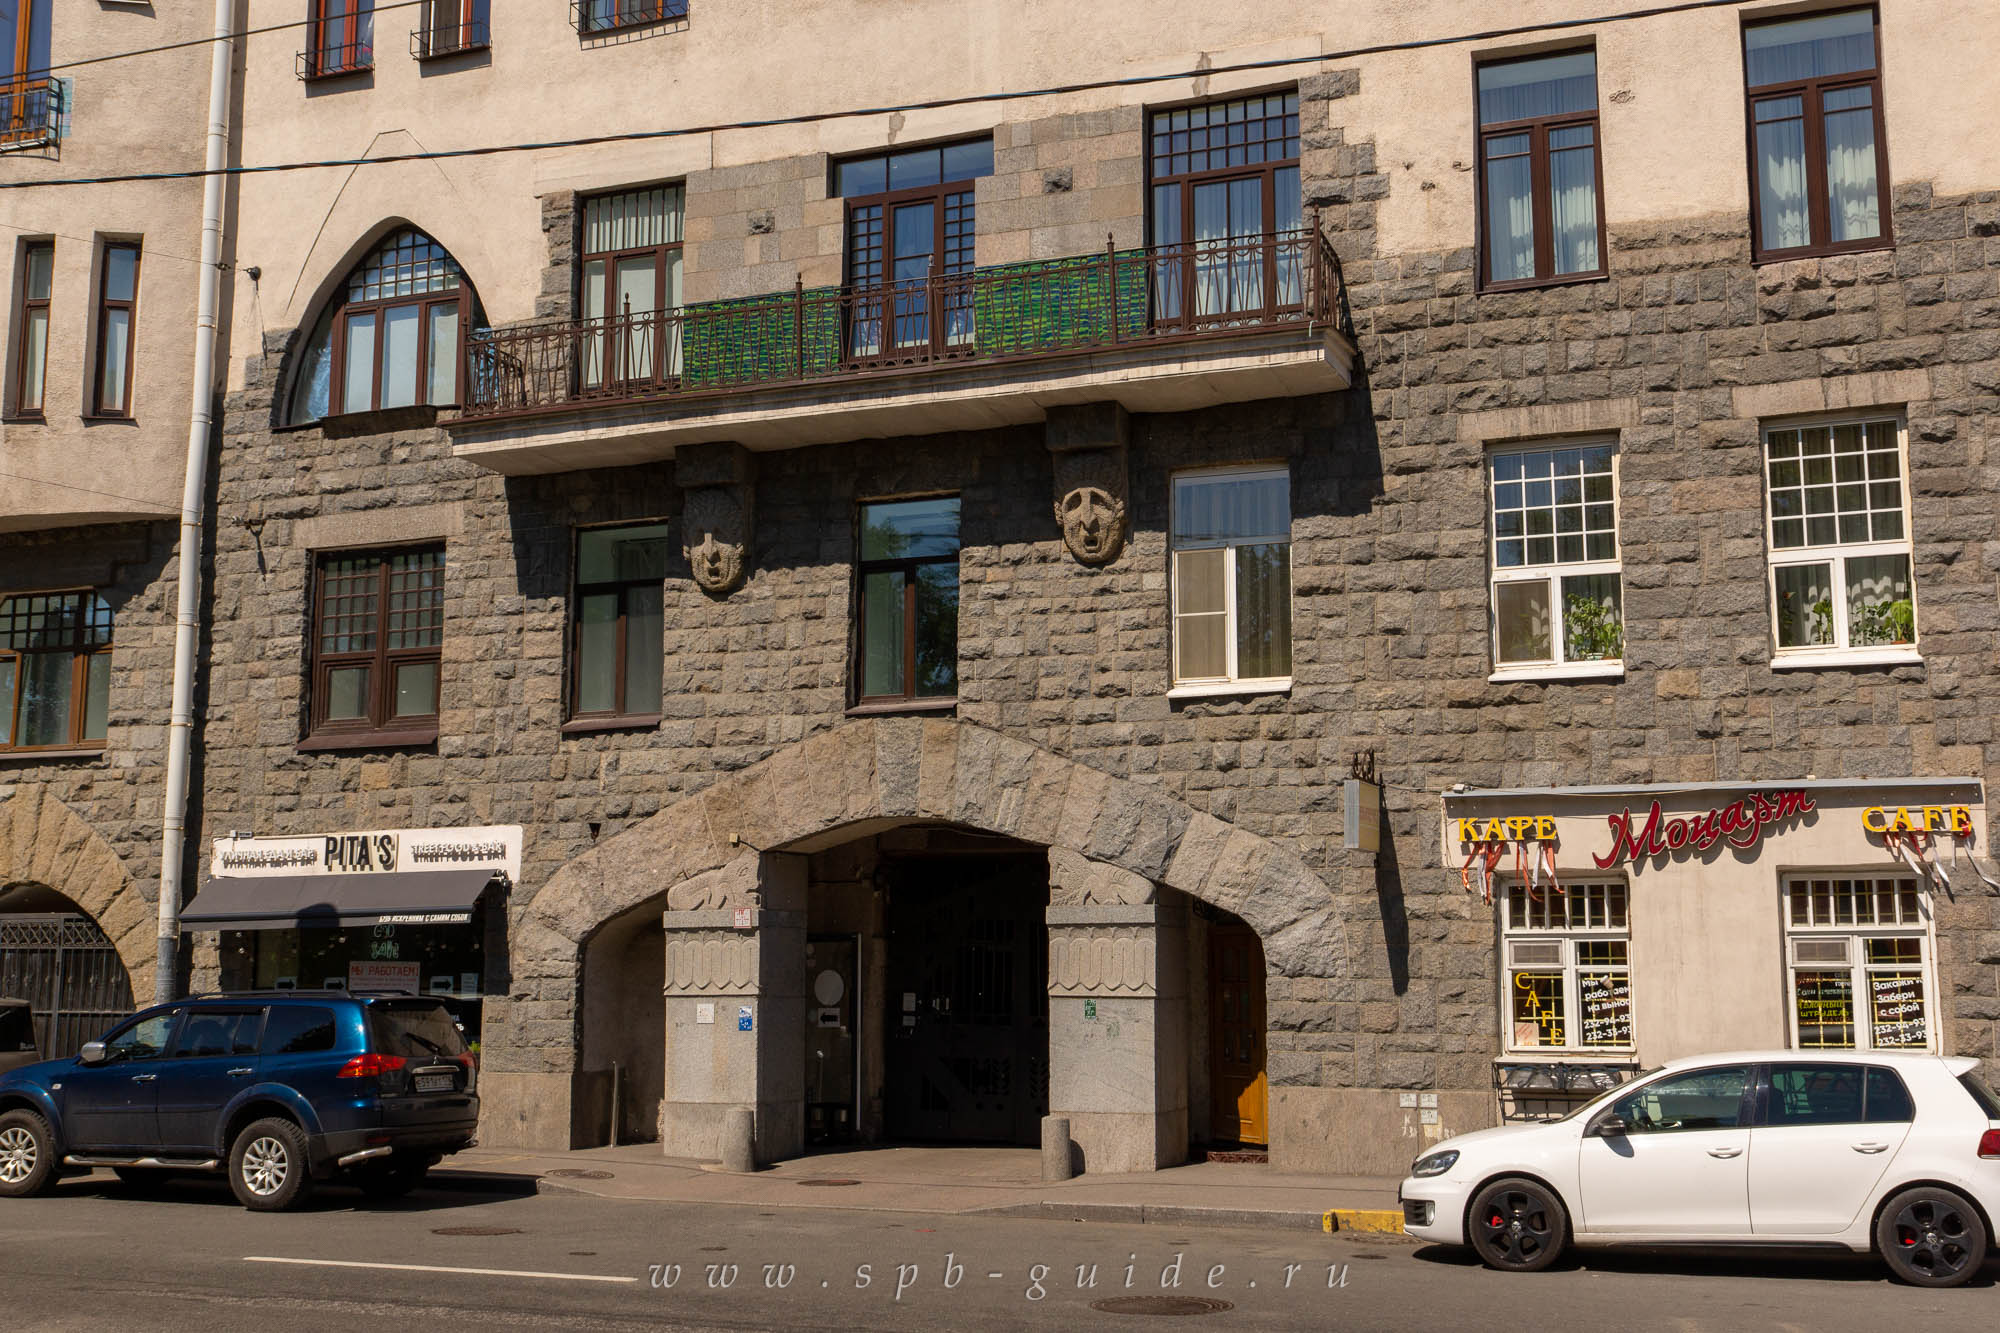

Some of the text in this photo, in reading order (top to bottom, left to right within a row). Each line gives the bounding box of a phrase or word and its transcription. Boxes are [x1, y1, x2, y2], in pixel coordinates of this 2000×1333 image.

[1457, 815, 1558, 842] КАФЕ
[1592, 788, 1816, 870] Моцарт
[1861, 805, 1973, 833] CAFE
[325, 834, 394, 867] PITA'S
